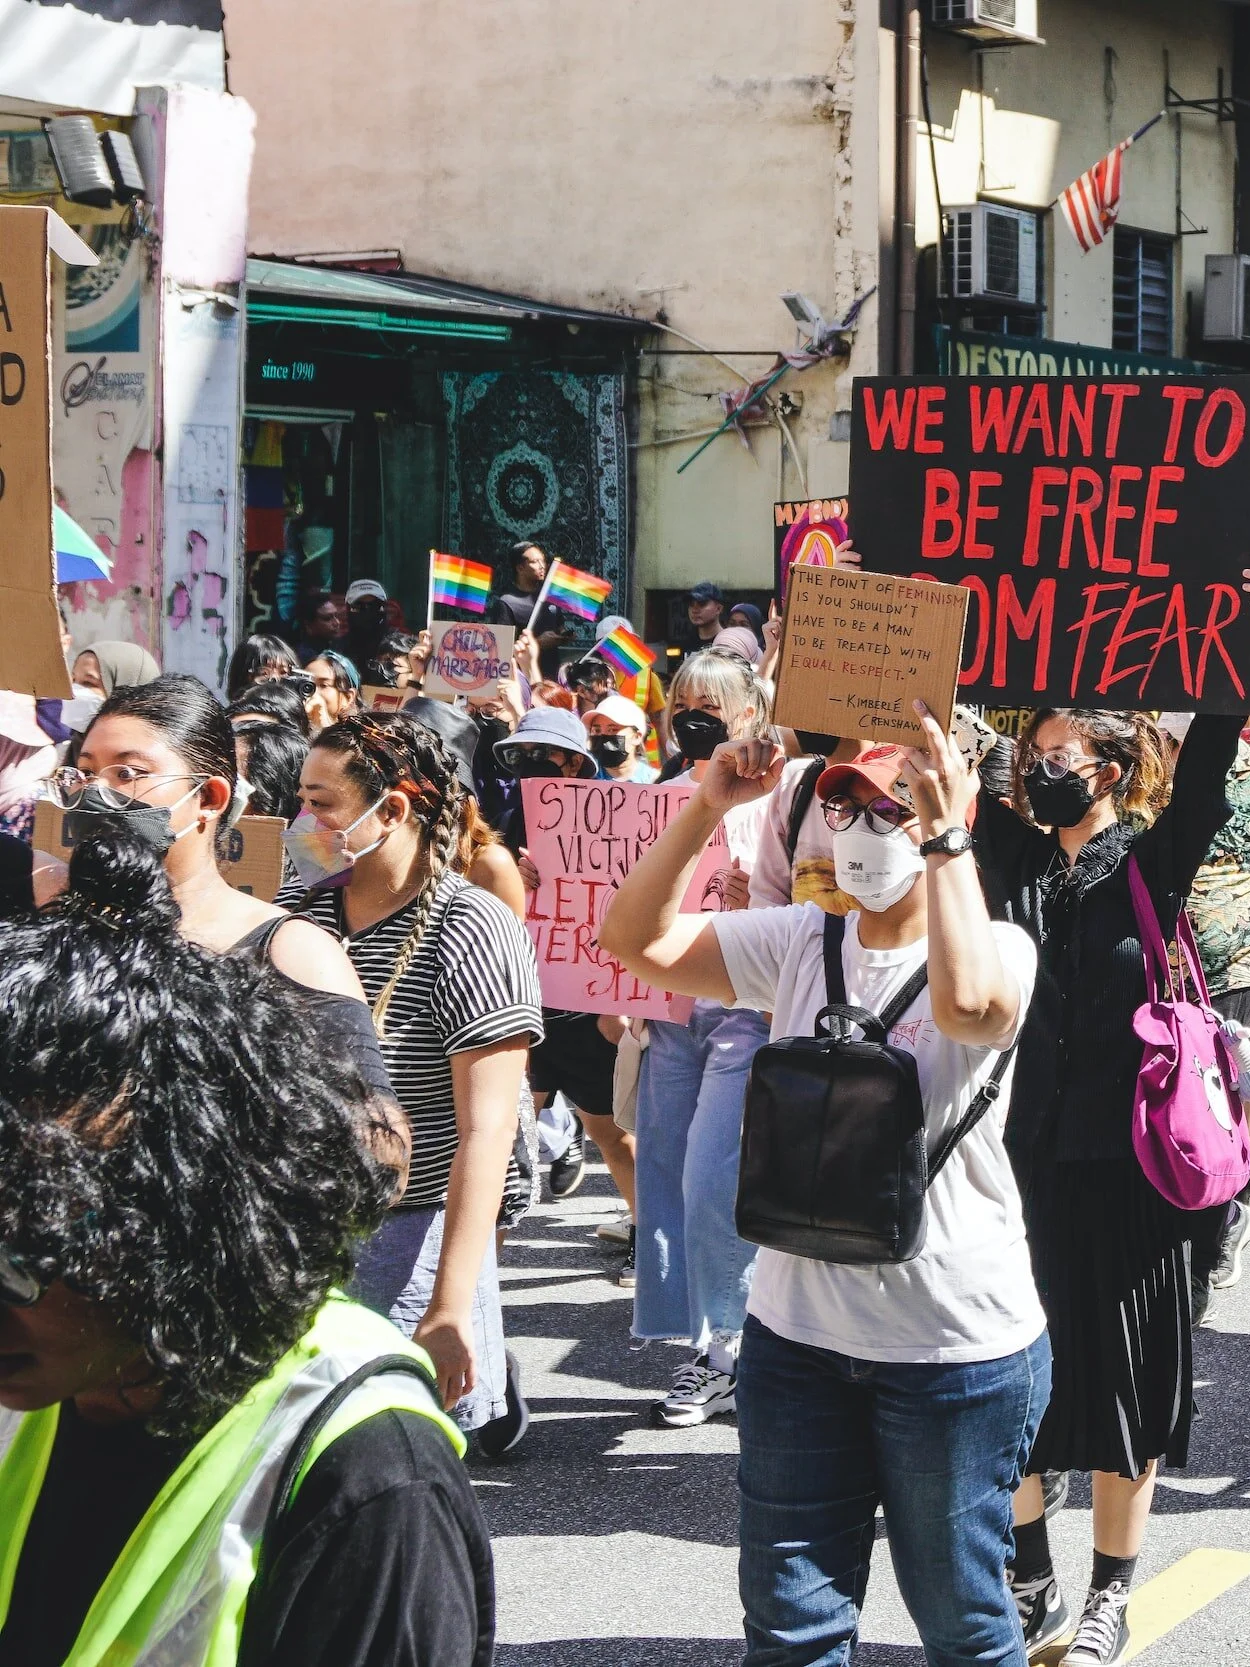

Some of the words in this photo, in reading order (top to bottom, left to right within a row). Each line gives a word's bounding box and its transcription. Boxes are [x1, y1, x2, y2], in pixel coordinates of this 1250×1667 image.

[262, 358, 288, 379] since
[292, 361, 315, 380] 1990
[862, 385, 946, 454] WE
[970, 383, 1140, 458] WANT
[1162, 385, 1247, 467] TO
[774, 503, 808, 527] MY
[921, 467, 1002, 559] BE
[1022, 466, 1185, 577] FREE
[797, 591, 809, 602] IS
[818, 594, 842, 608] YOU
[850, 599, 919, 618] SHOULDN'T
[830, 575, 869, 590] POINT
[876, 583, 893, 592] OF
[897, 585, 964, 608] FEMINISM
[793, 615, 825, 628] HAVE
[833, 617, 847, 628] TO
[852, 619, 866, 632] BE
[873, 624, 879, 632] A
[887, 623, 913, 637] MAN
[908, 572, 1057, 692] OM
[1067, 581, 1247, 700] FEAR
[792, 634, 806, 647] TO
[812, 637, 825, 650] BE
[837, 638, 891, 655] TREATED
[900, 648, 931, 661] WITH
[791, 654, 835, 672] EQUAL
[858, 714, 921, 732] CRENSHAW
[537, 783, 626, 835] STOP
[848, 861, 863, 871] 3M
[526, 877, 609, 927] LET
